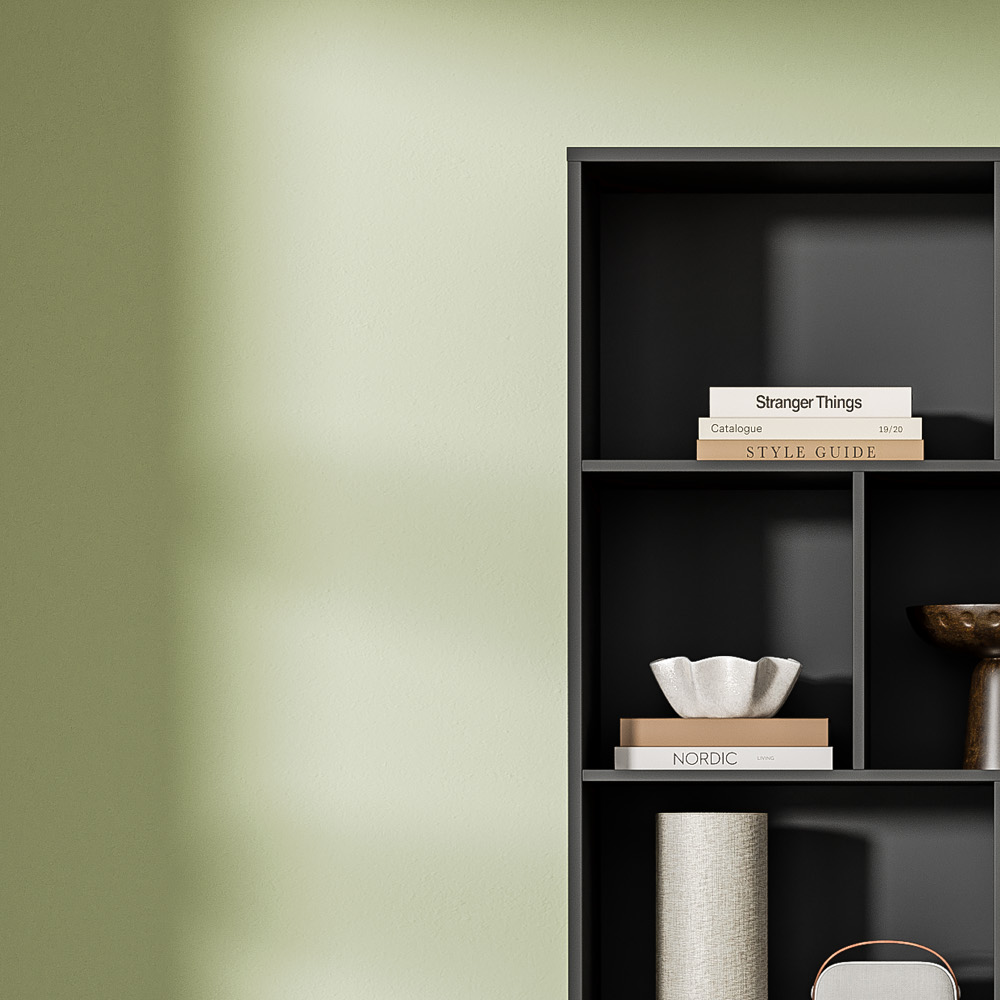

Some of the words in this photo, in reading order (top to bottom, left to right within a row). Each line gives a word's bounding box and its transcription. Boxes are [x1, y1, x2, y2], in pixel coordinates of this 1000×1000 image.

[756, 395, 814, 412] Stranger
[816, 395, 862, 412] Things
[711, 424, 763, 435] Catalogue
[879, 425, 903, 433] 19/20
[746, 446, 805, 458] STYLE
[815, 446, 876, 458] GUIDE
[673, 752, 737, 765] NORDIC
